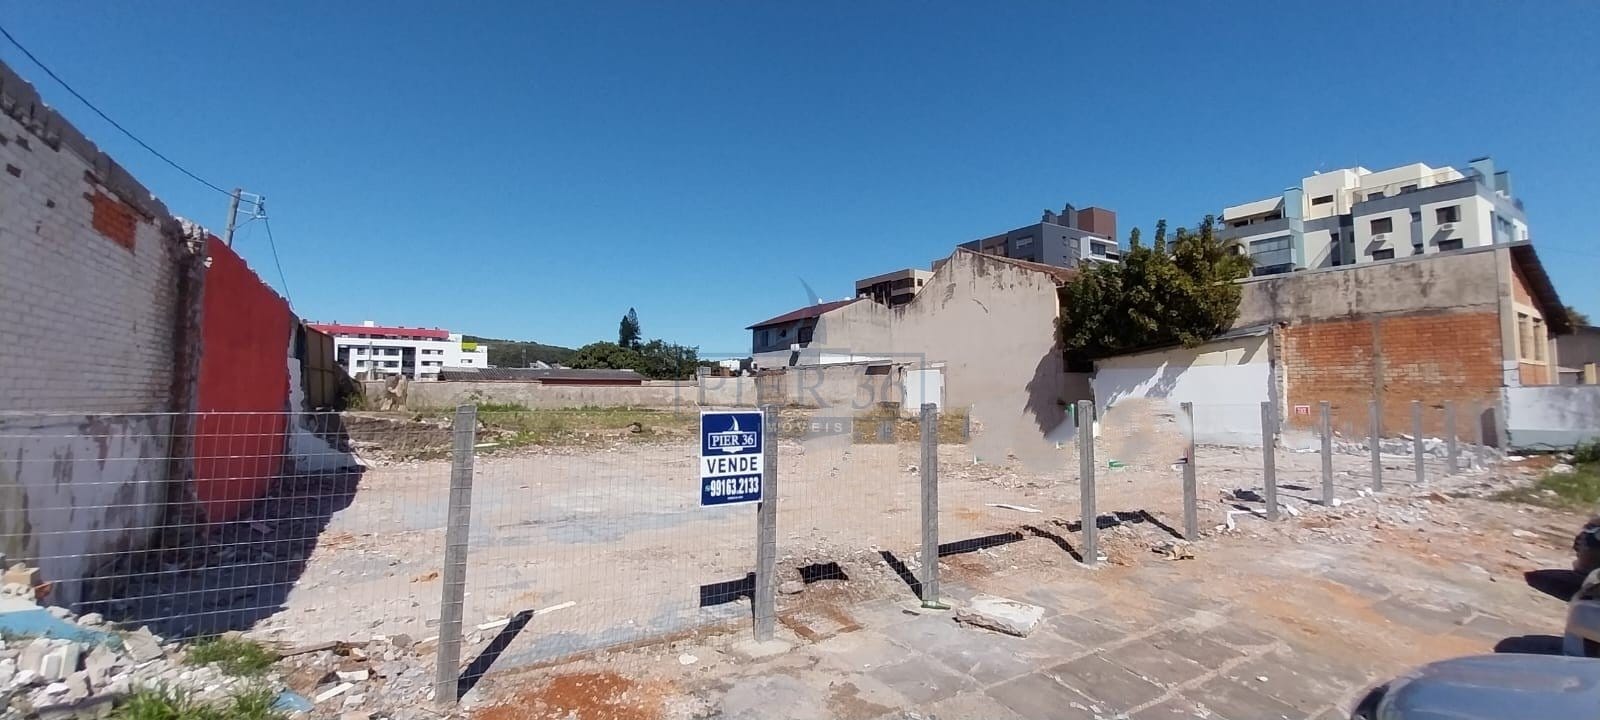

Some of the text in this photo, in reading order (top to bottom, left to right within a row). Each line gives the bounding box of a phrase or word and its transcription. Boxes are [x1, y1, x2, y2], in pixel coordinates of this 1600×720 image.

[711, 434, 754, 447] PIER 36
[707, 456, 758, 474] VENDE
[710, 476, 759, 497] 99163.2133
